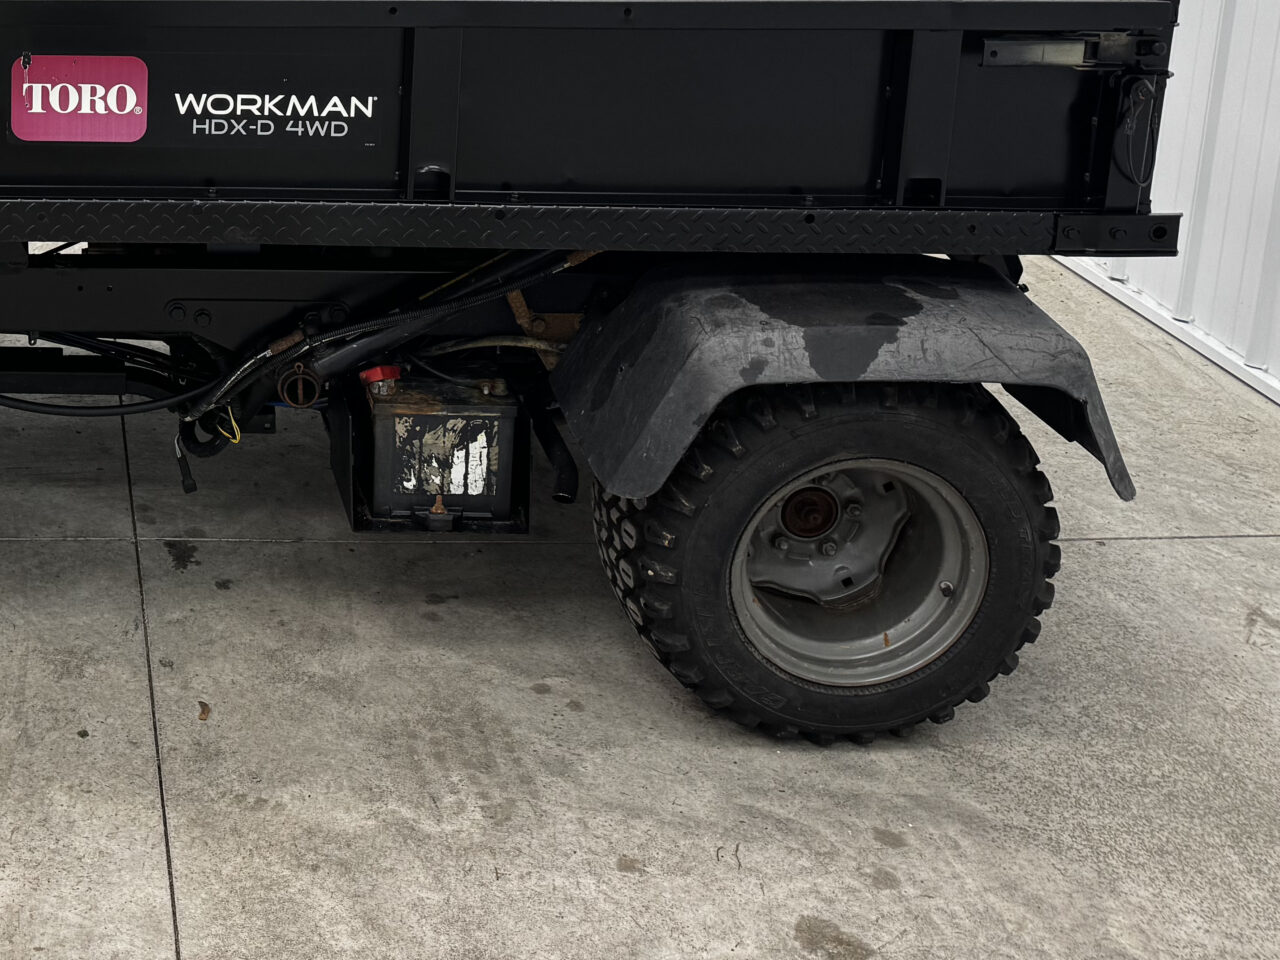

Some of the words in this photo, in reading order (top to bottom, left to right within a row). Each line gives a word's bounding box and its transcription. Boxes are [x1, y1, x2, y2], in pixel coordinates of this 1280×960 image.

[22, 83, 138, 115] TORO
[174, 92, 374, 118] WORKMAN
[192, 118, 275, 136] HDX-D
[285, 119, 350, 137] 4WD
